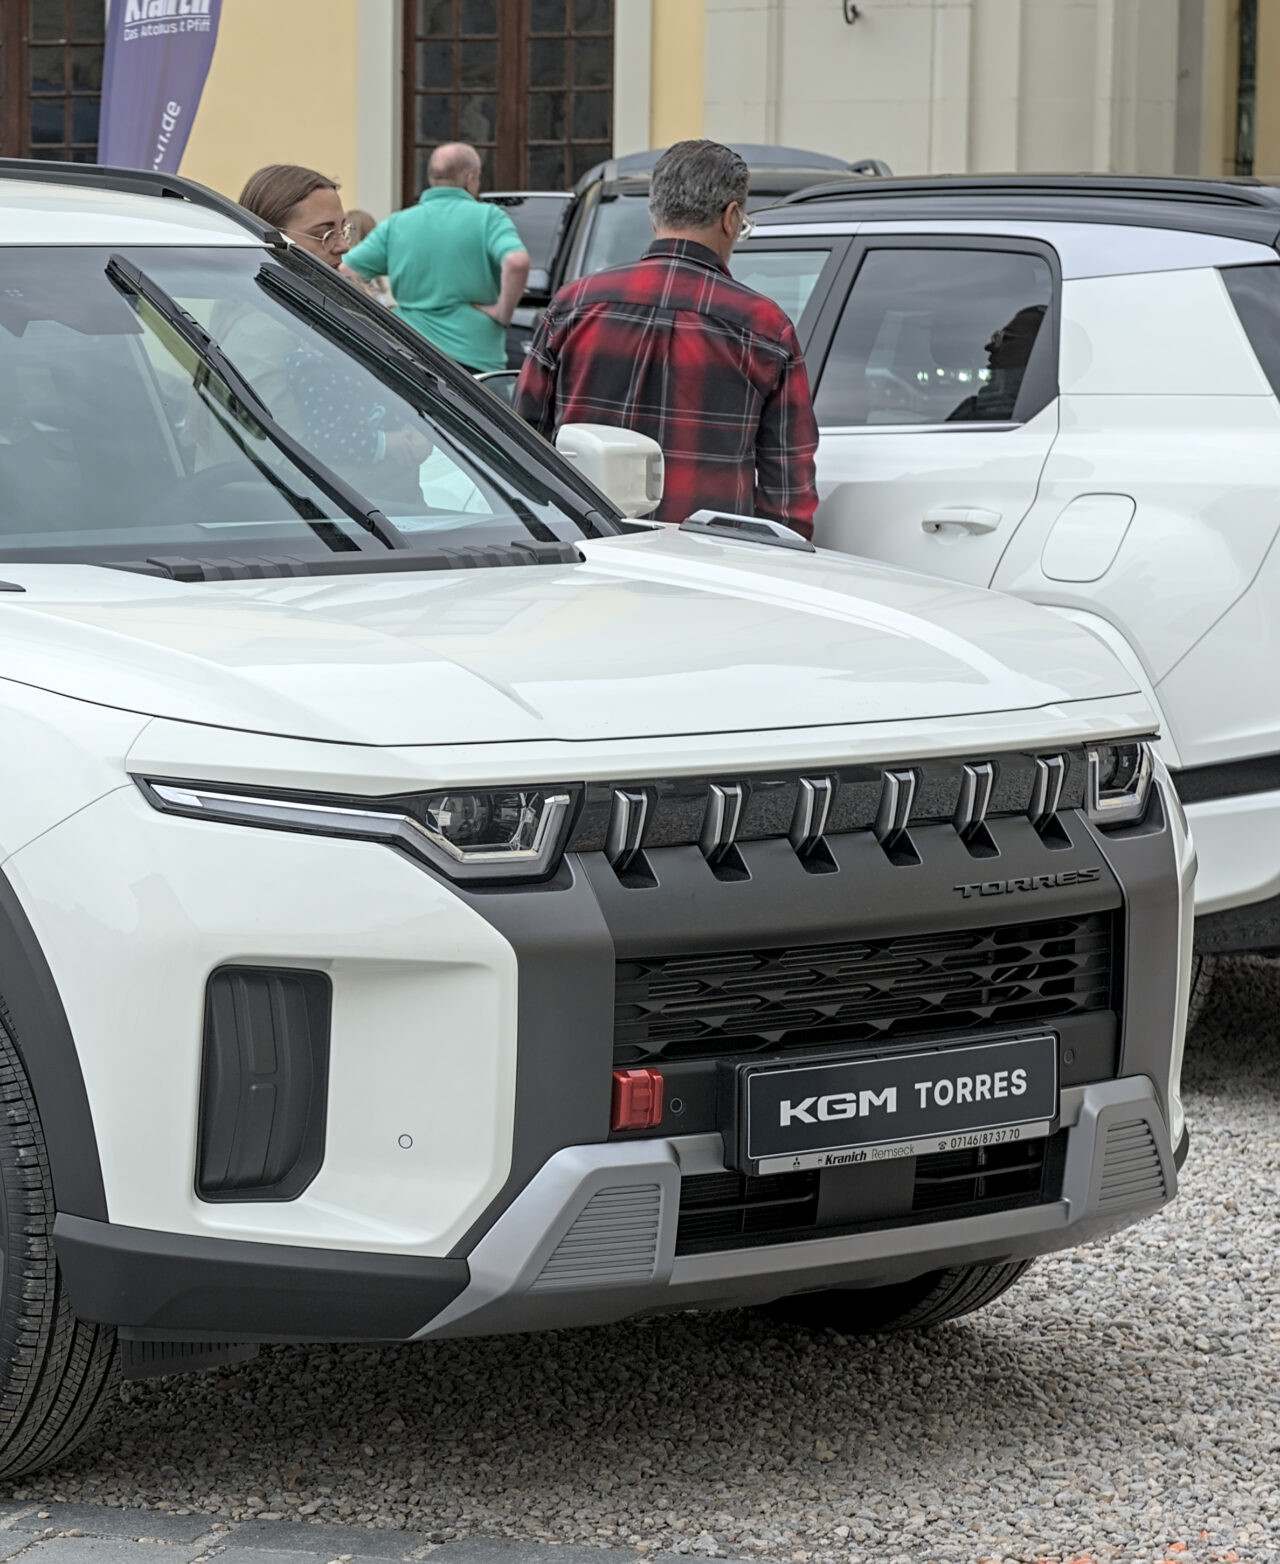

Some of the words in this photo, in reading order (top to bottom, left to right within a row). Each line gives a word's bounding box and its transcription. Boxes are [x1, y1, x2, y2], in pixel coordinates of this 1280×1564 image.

[953, 867, 1101, 899] TORRES
[780, 1087, 897, 1127] KGM
[914, 1068, 1028, 1109] TORRES
[825, 1150, 867, 1166] Kranich
[871, 1143, 915, 1160] Remseck
[950, 1131, 994, 1149] 07146/87
[995, 1130, 1008, 1144] 37
[1009, 1128, 1020, 1141] 70
